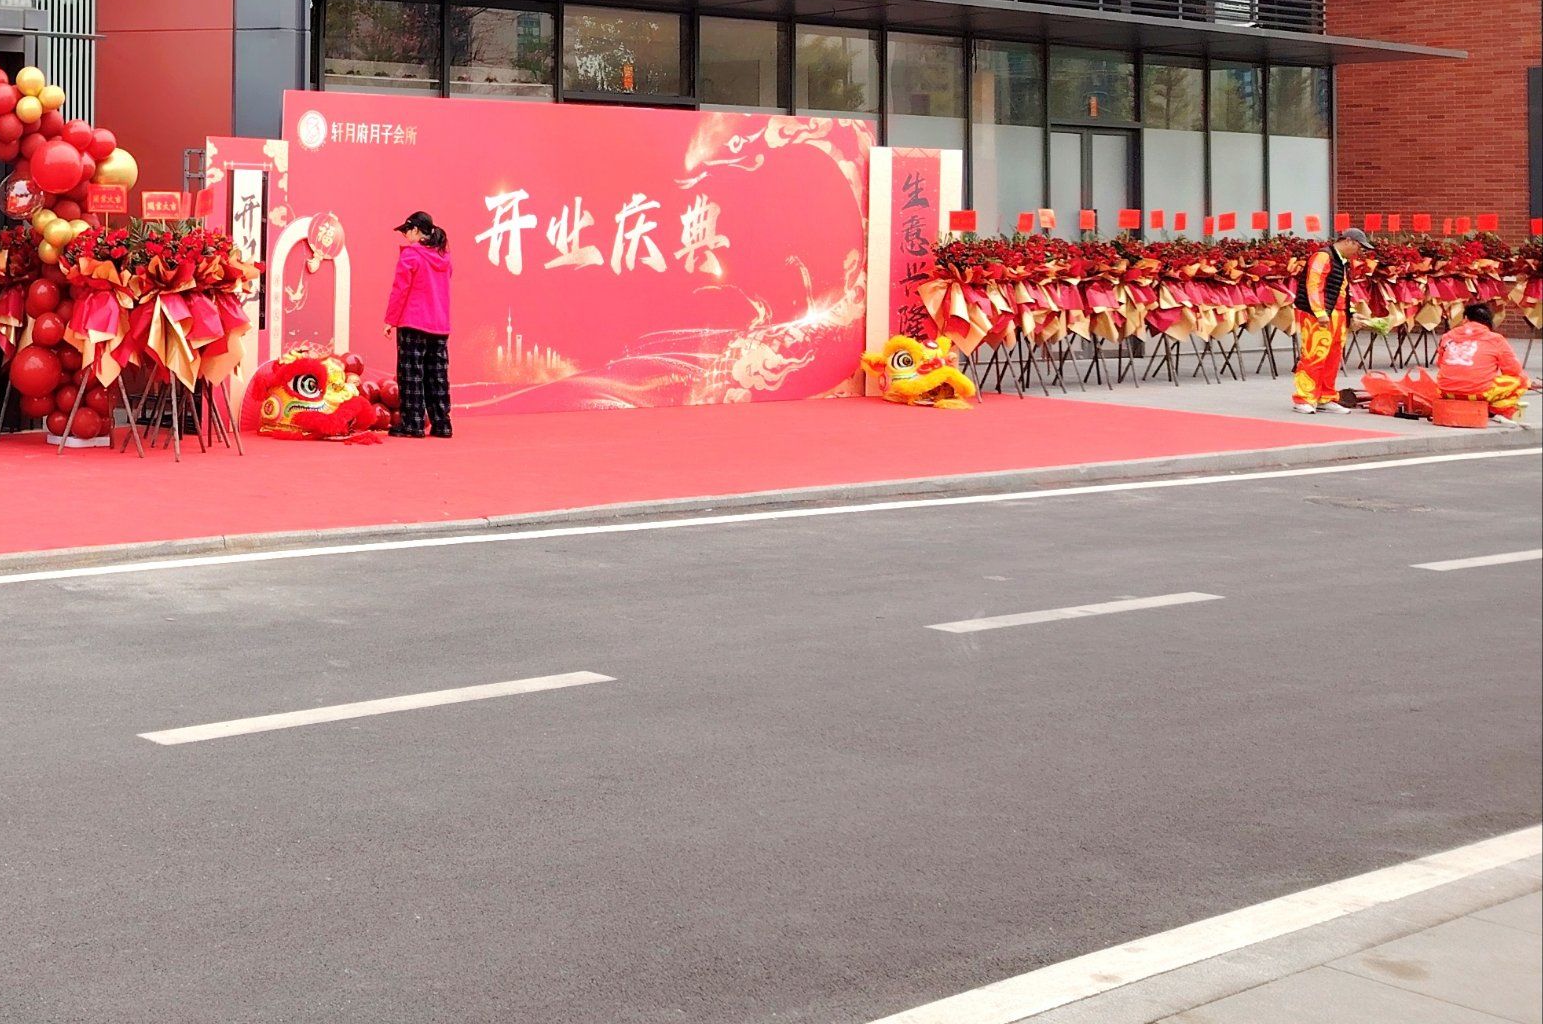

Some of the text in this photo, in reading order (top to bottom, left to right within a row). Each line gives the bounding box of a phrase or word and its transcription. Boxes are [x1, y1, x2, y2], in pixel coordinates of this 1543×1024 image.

[331, 121, 418, 146] 轩月府月子会所
[317, 222, 337, 247] 福
[475, 188, 732, 276] 开业庆典
